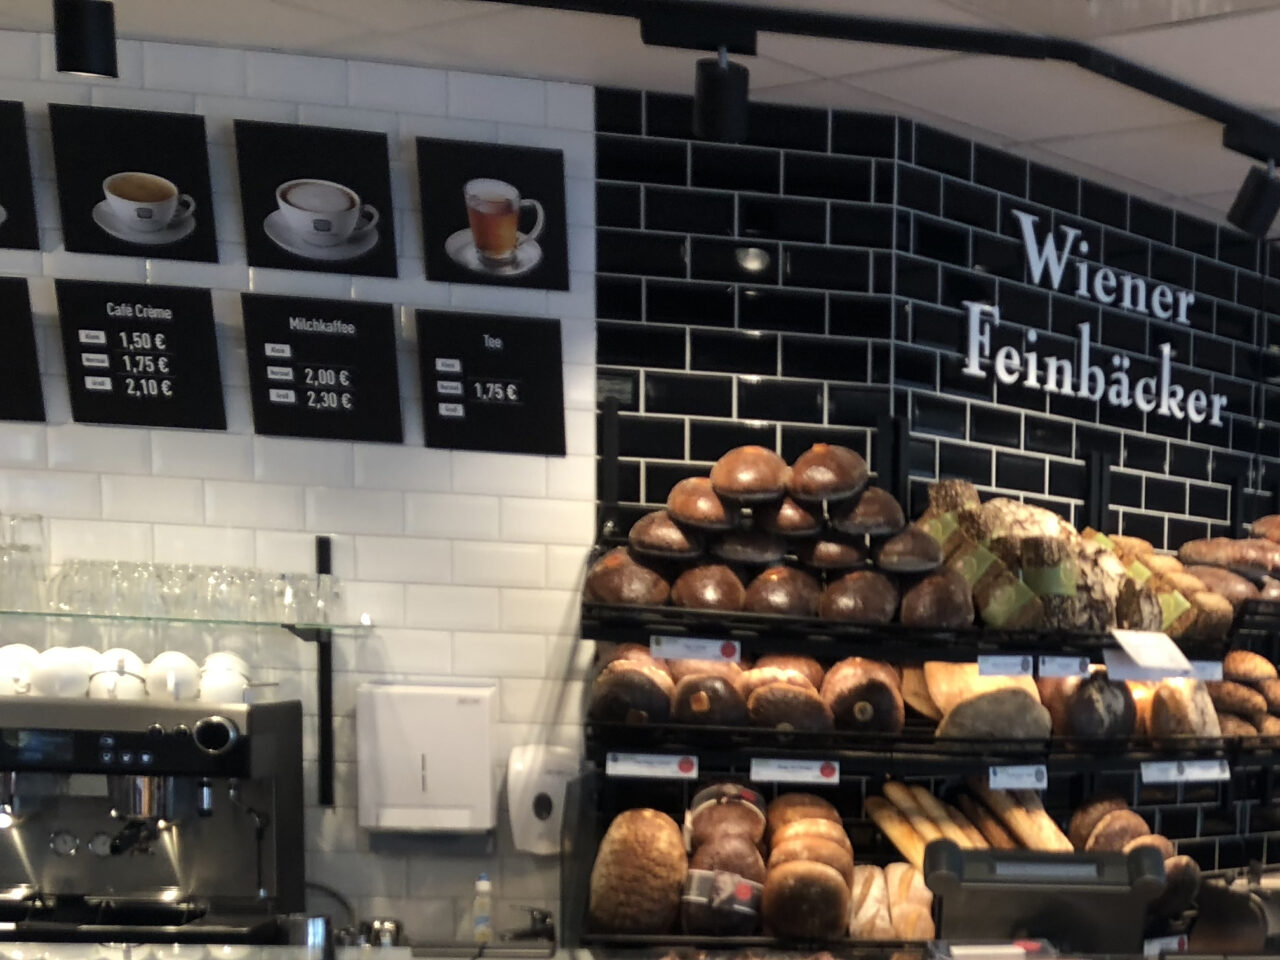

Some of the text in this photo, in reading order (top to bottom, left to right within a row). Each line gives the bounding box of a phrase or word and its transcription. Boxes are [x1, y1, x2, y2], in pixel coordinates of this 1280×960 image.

[1011, 208, 1196, 326] Wiener
[106, 302, 173, 319] Café Crème
[289, 316, 356, 334] Milchkaffee
[119, 331, 166, 351] 1,50 €
[483, 334, 503, 349] Tee
[122, 355, 155, 374] 1,75
[158, 356, 170, 373] €
[961, 300, 1228, 427] Feinbäcker
[304, 368, 350, 387] 2,00 €
[125, 378, 173, 397] 2,10 €
[474, 382, 505, 400] 1,75
[506, 384, 518, 400] €
[306, 391, 338, 410] 2,30
[341, 393, 353, 409] €
